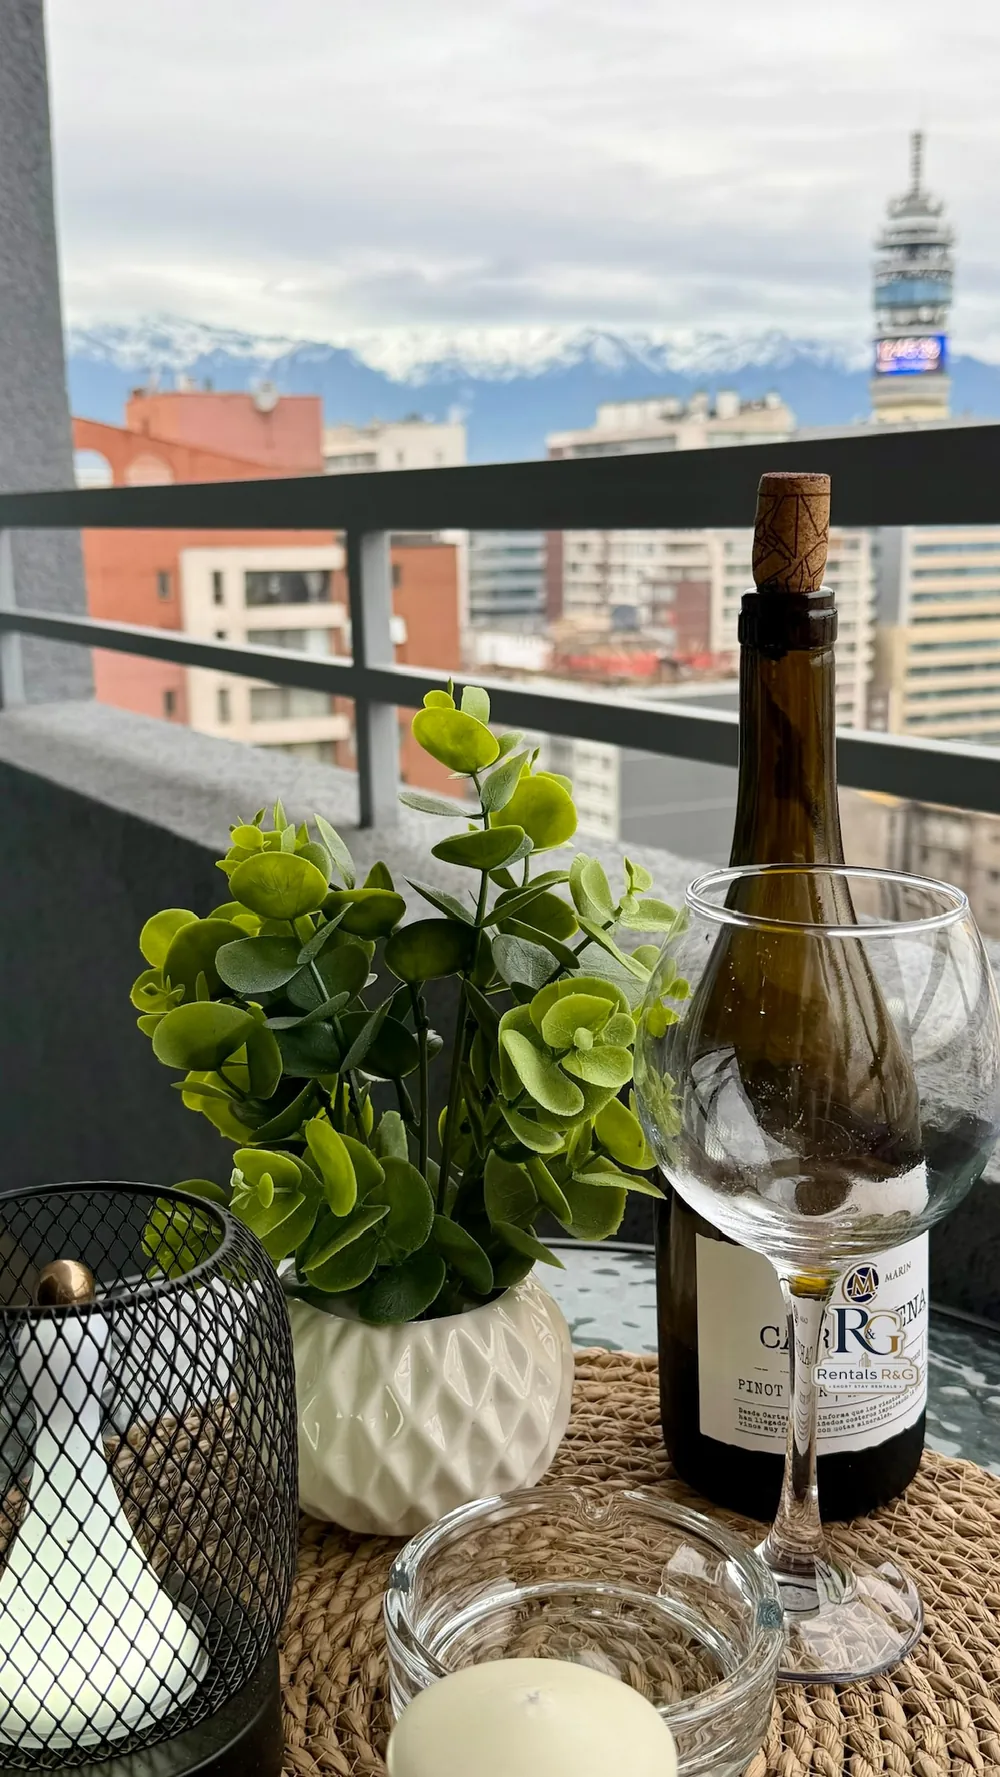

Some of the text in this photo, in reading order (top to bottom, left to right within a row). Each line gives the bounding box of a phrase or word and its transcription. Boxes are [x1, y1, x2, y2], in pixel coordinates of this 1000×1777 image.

[884, 1261, 912, 1283] MARIN
[738, 1378, 784, 1397] PINOT
[738, 1407, 760, 1417] Desde
[818, 1412, 850, 1420] informa
[851, 1409, 864, 1417] que
[878, 1395, 901, 1407] vientos
[738, 1414, 753, 1422] han
[754, 1417, 787, 1427] llegado
[846, 1412, 877, 1423] costeros
[738, 1421, 761, 1430] vinos
[834, 1423, 855, 1432] notas
[856, 1412, 893, 1427] minerales.
